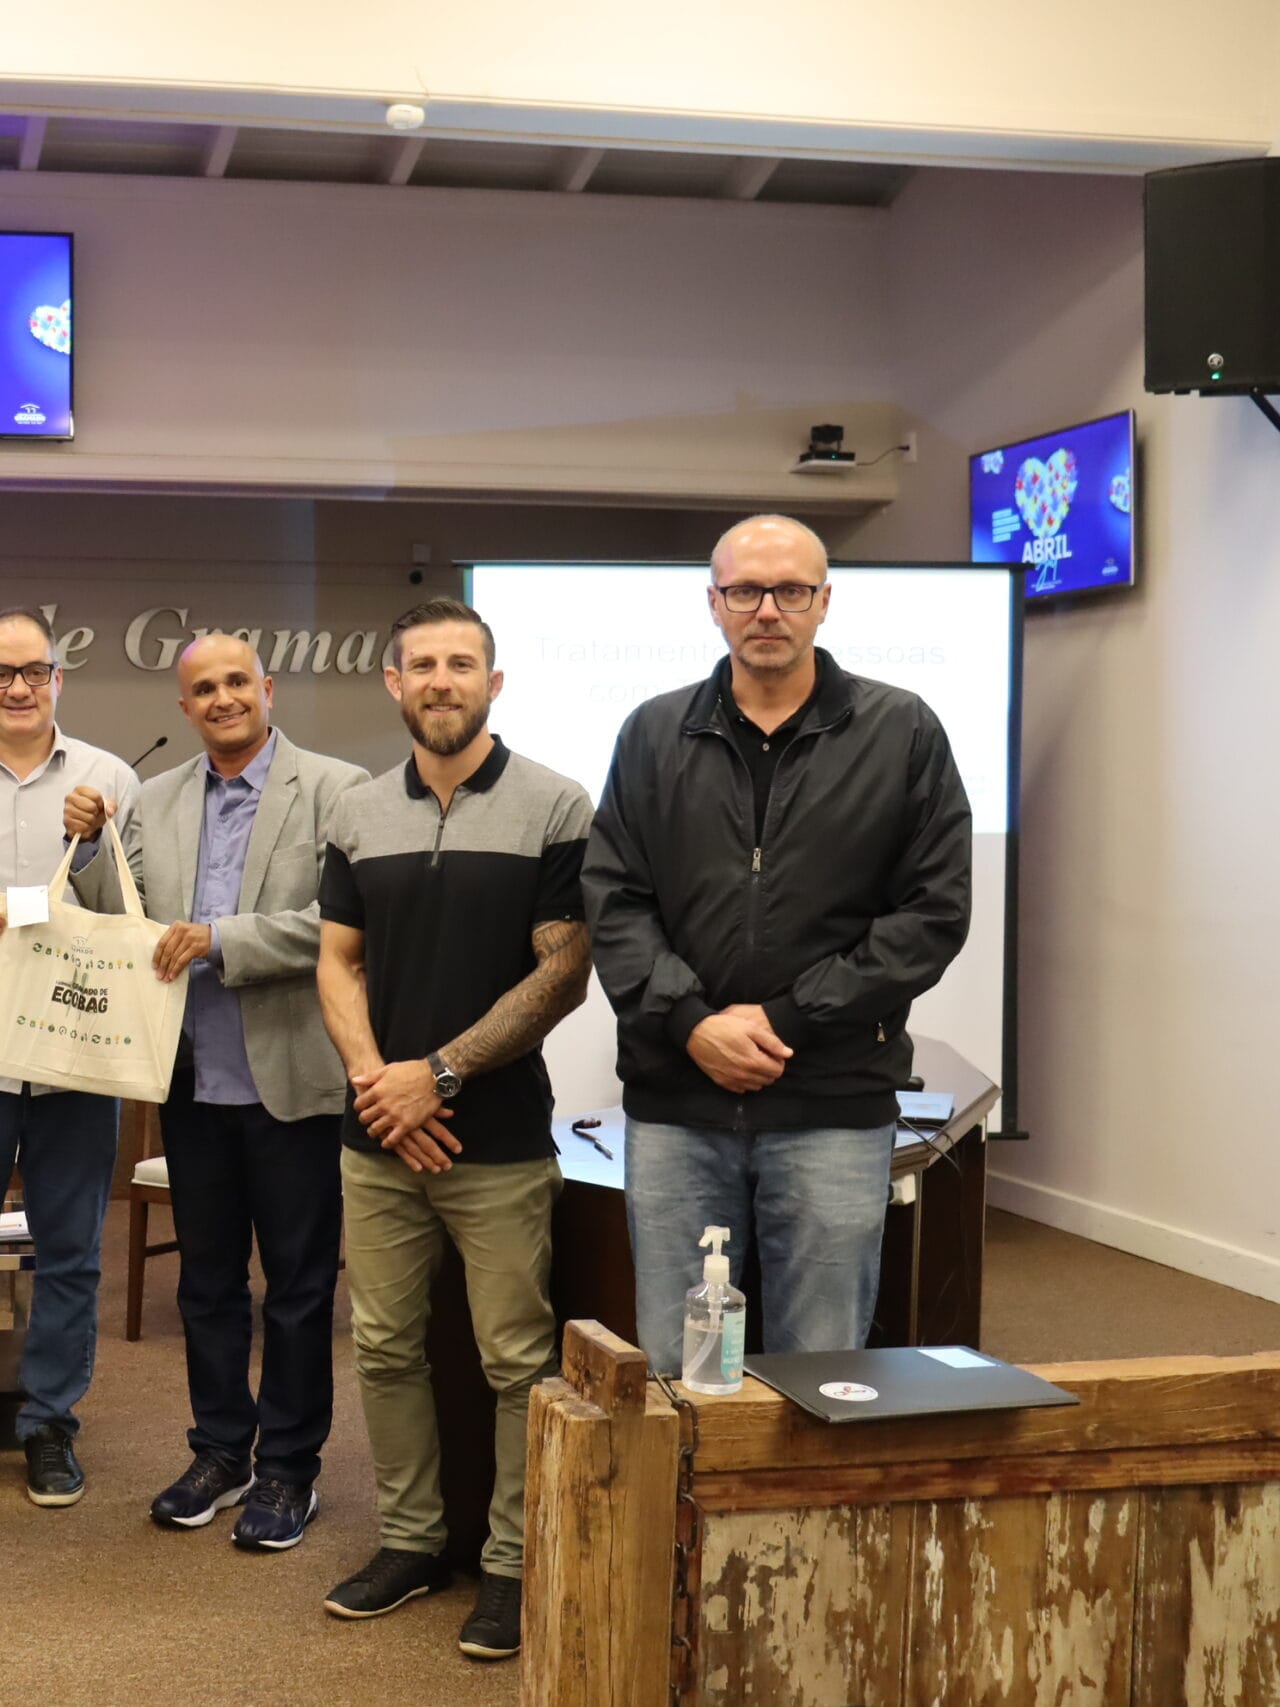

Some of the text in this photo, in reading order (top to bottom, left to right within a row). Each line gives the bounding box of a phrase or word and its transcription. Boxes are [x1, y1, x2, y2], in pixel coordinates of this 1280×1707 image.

[1022, 534, 1072, 564] ABRIL
[828, 645, 946, 665] essoas
[51, 985, 109, 1014] ECOBAG
